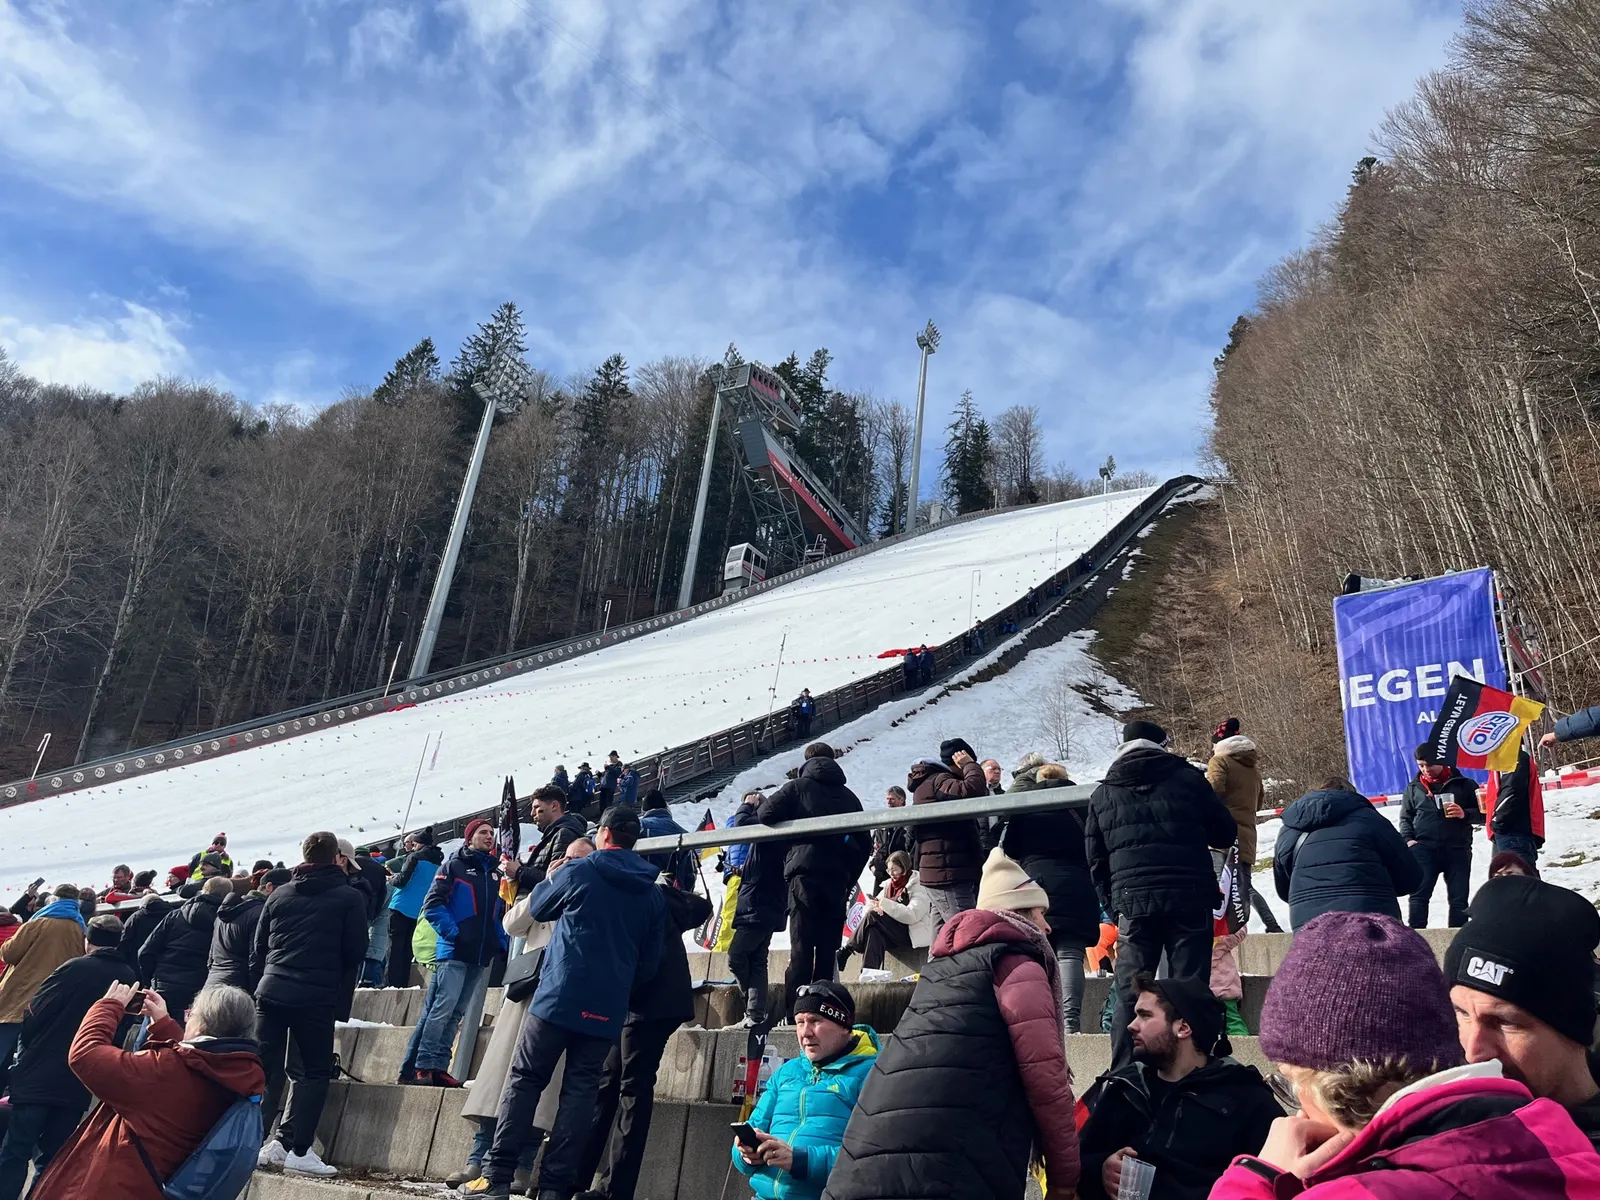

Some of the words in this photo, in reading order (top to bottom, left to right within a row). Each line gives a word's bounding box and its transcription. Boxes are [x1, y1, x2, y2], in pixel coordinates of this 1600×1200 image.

[1231, 868, 1245, 923] GERMANY
[1467, 956, 1509, 986] CAT
[820, 1004, 845, 1022] E.O.F.T.
